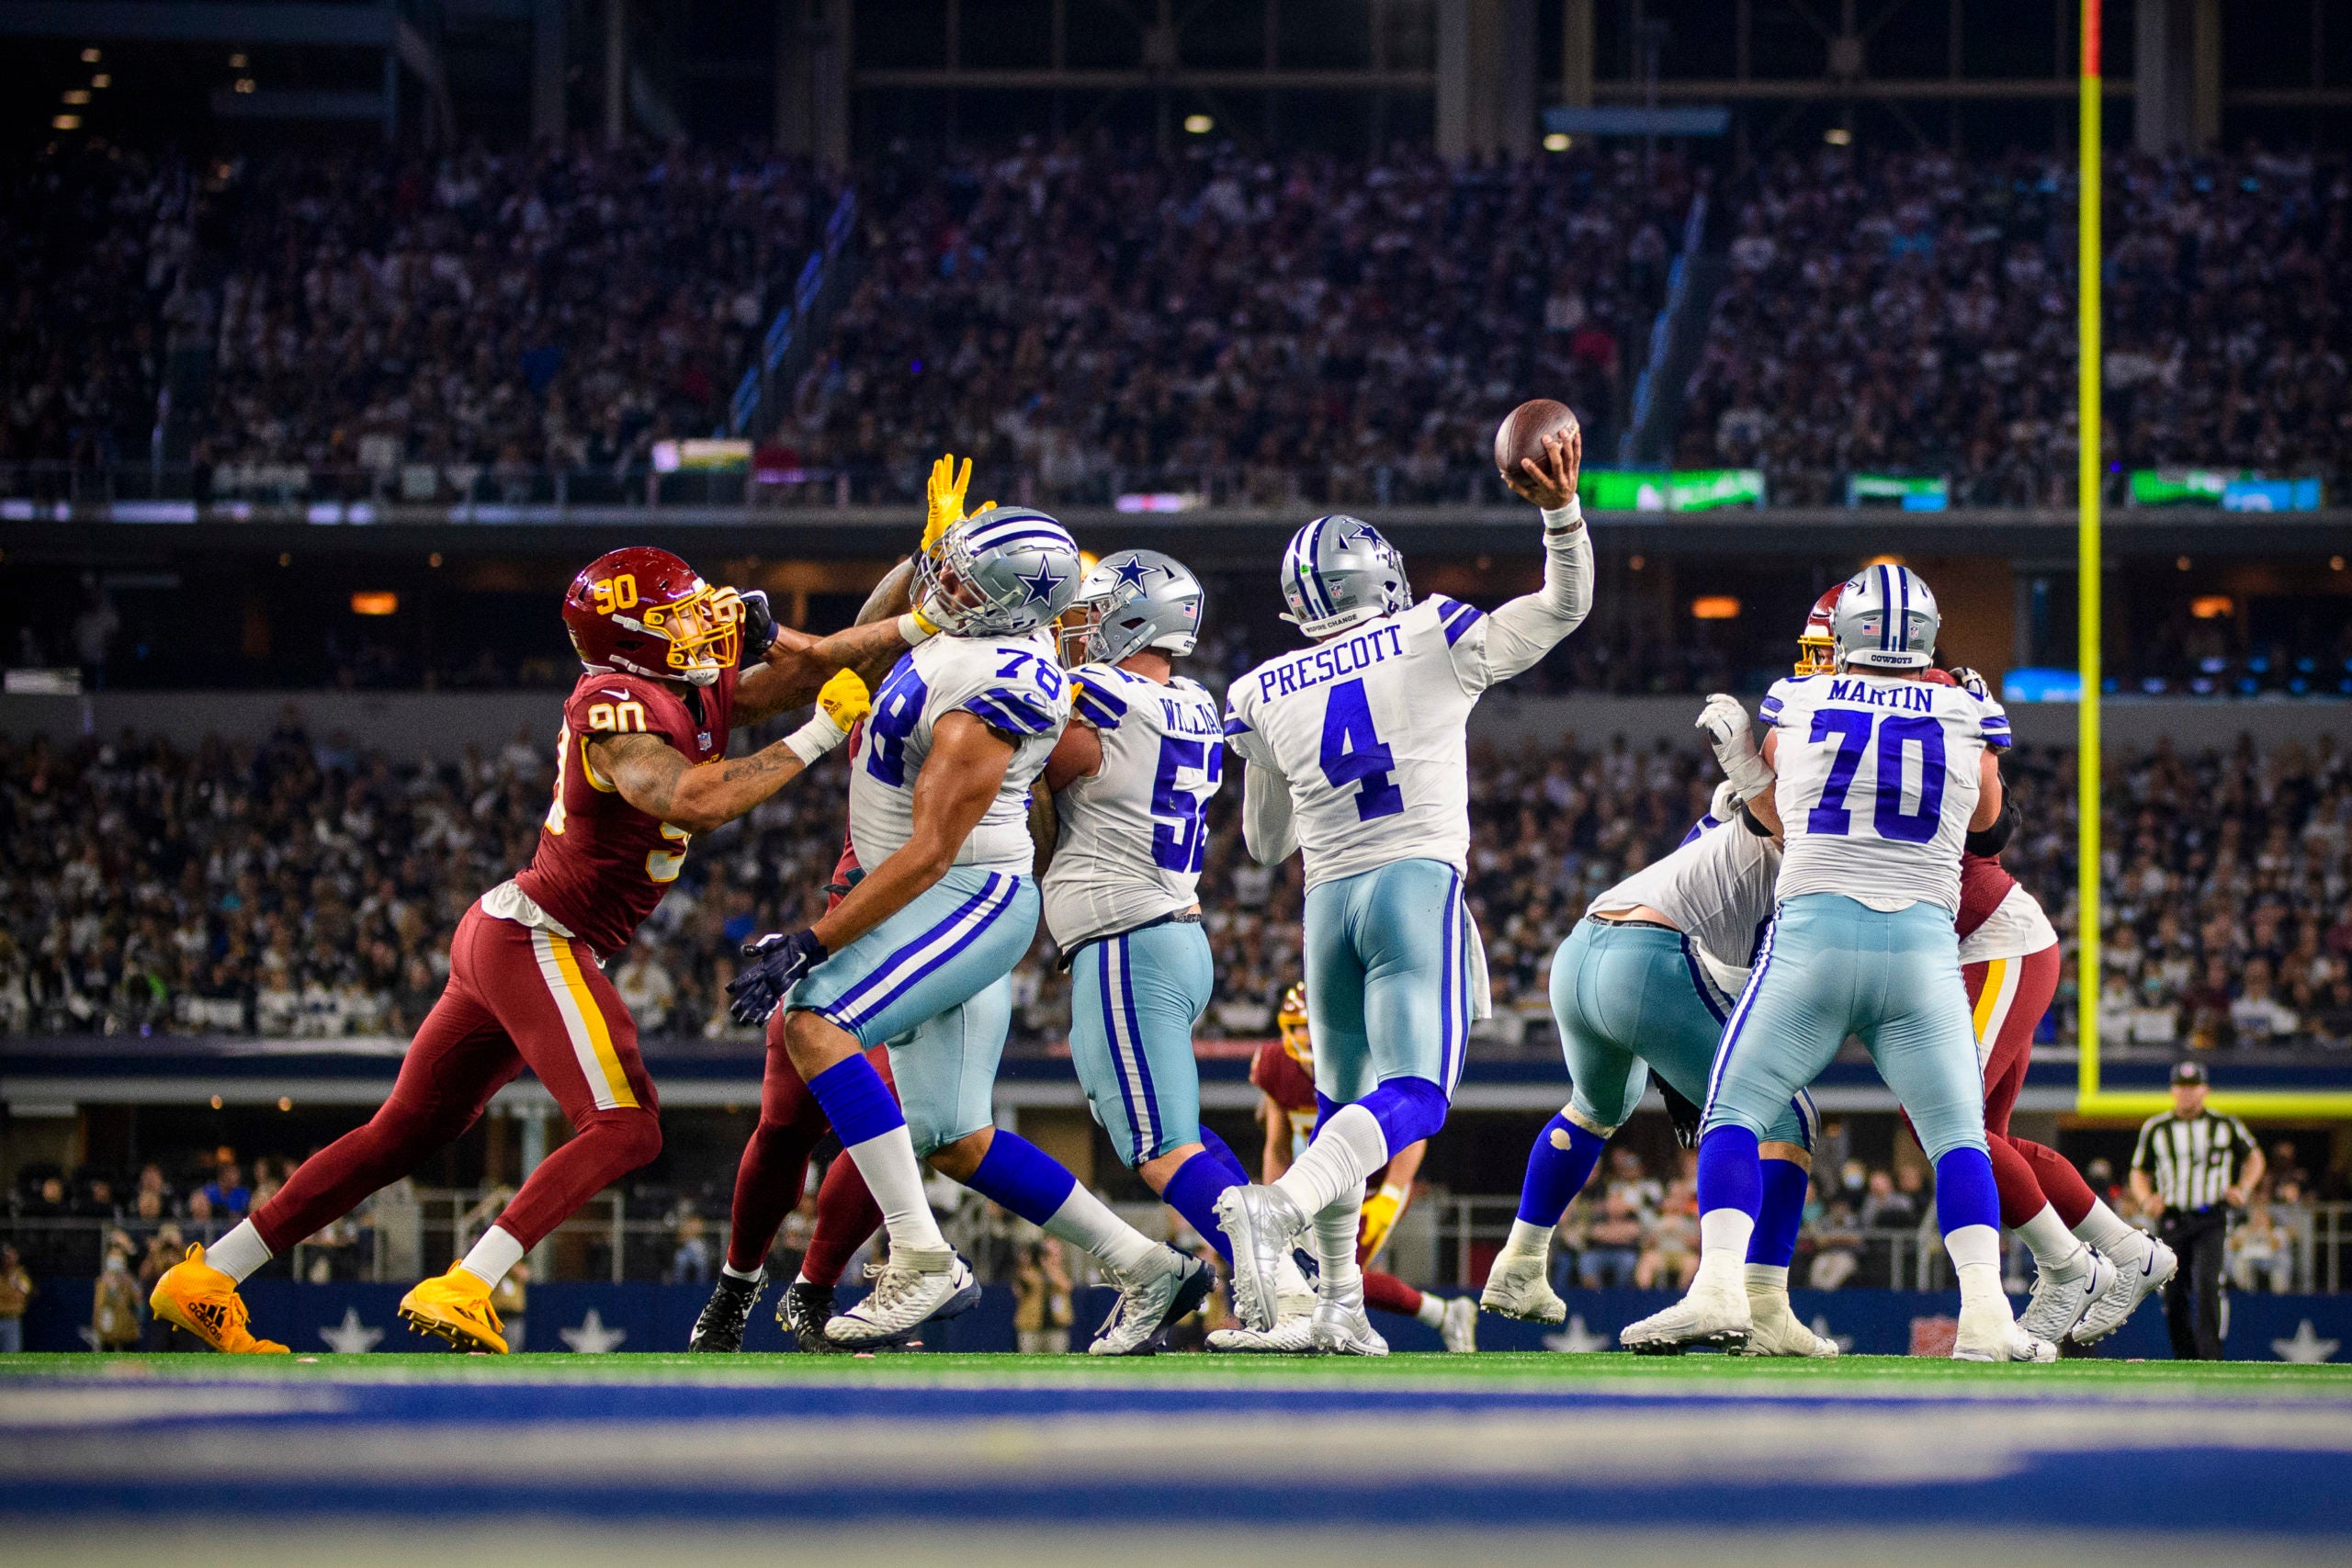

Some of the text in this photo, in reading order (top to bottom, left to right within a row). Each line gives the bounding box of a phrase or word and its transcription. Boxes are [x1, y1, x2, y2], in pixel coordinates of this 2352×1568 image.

[594, 574, 639, 615] 90
[1328, 614, 1358, 628] CHANGE
[995, 648, 1062, 701] 78
[1259, 625, 1403, 704] PRESCOTT
[1871, 654, 1913, 664] COWBOYS
[1826, 680, 1934, 713] MARTIN
[588, 701, 647, 733] 90
[1319, 677, 1405, 822] 4
[1806, 708, 1947, 844] 70
[187, 1302, 222, 1341] adidas
